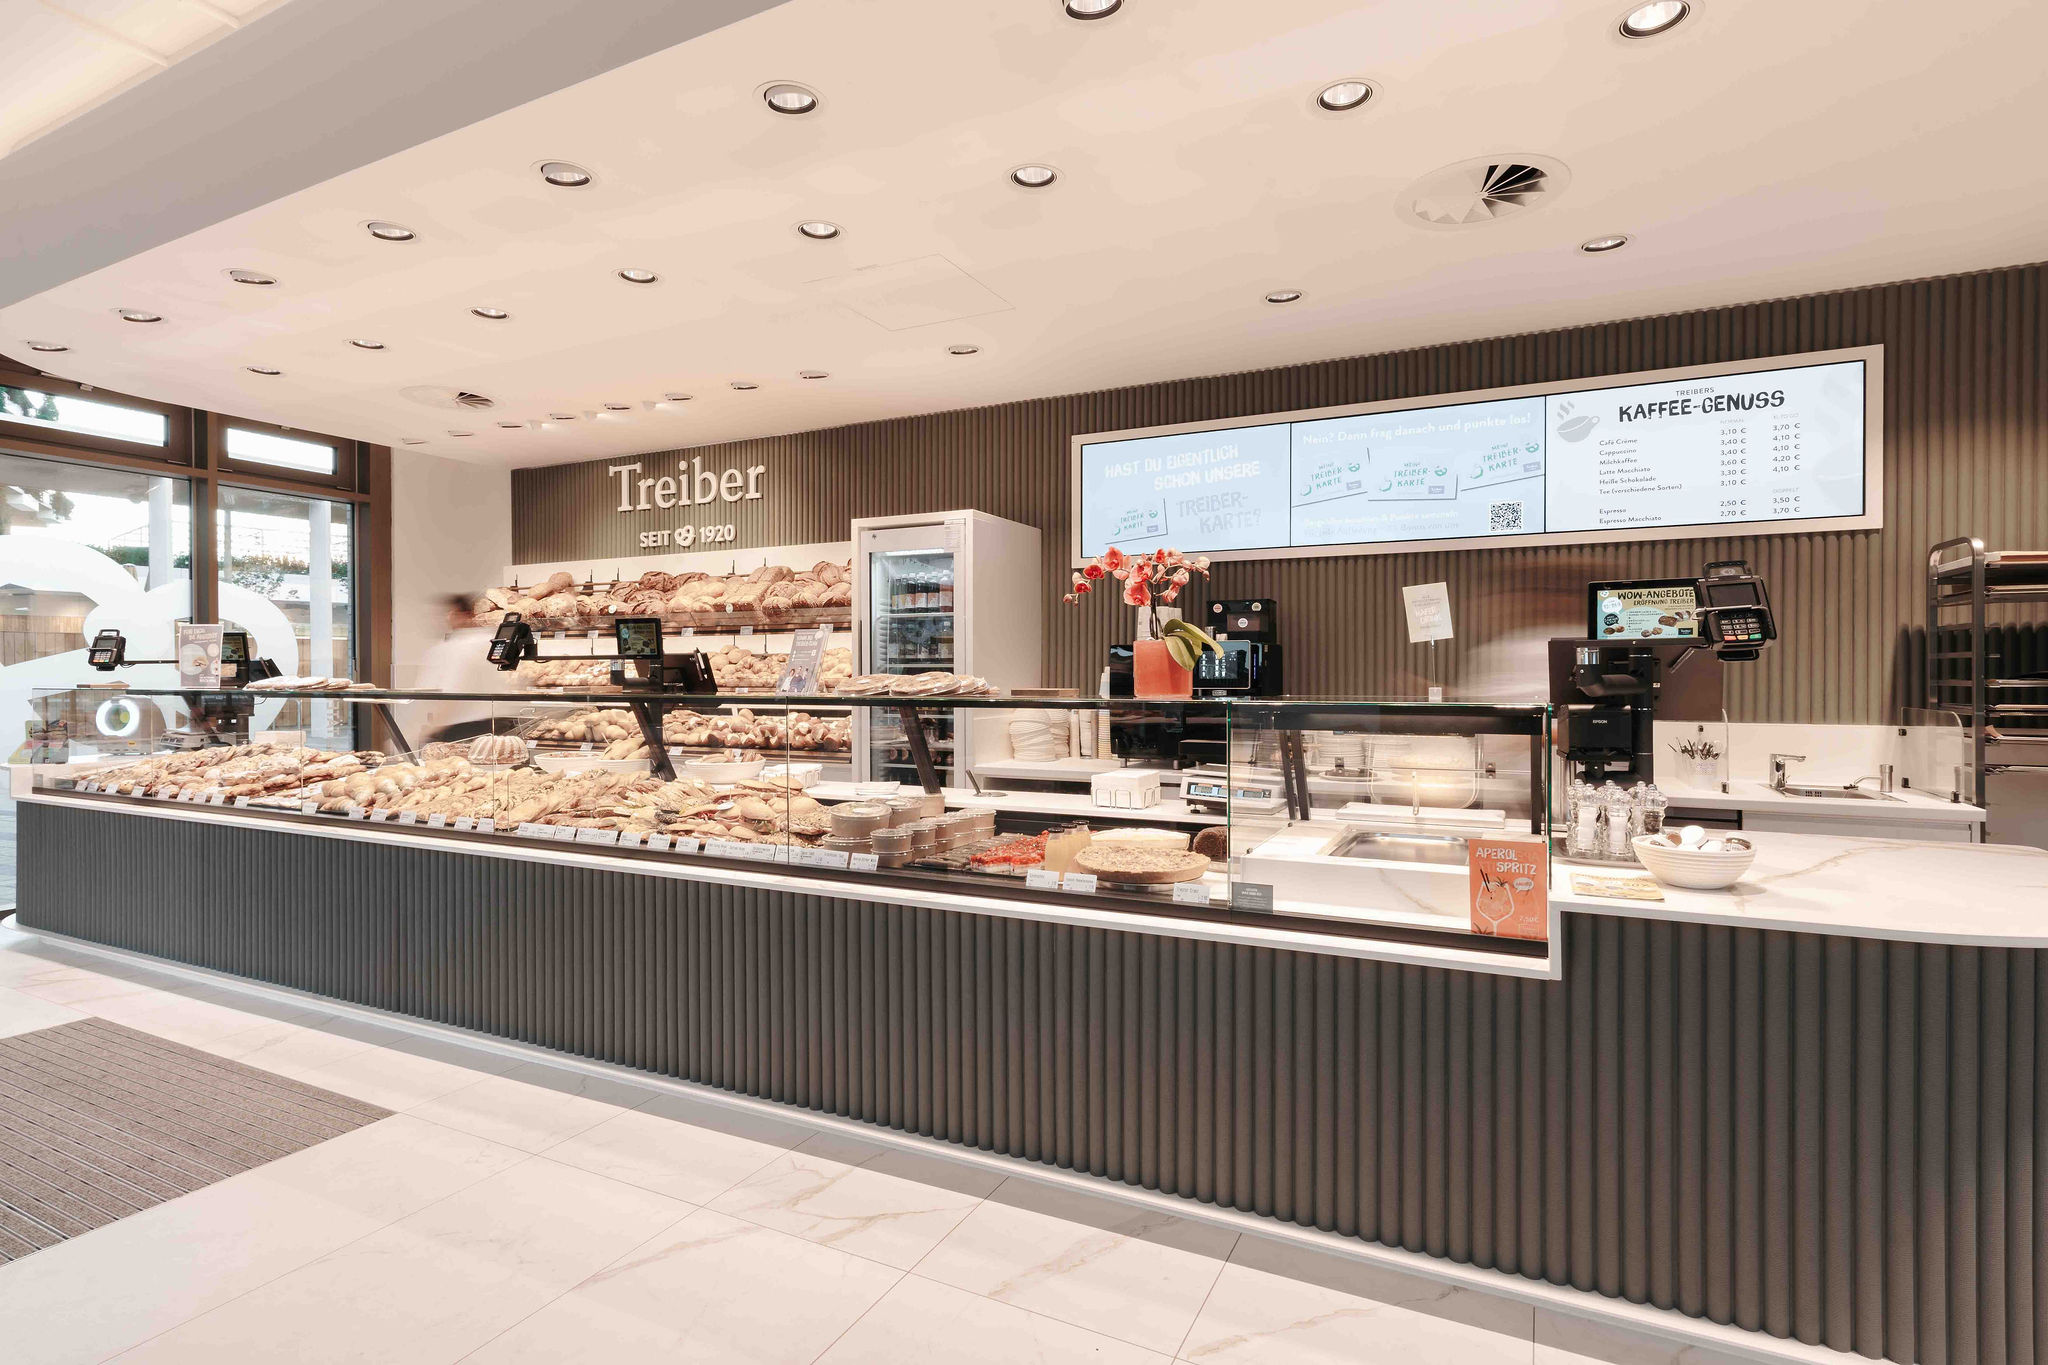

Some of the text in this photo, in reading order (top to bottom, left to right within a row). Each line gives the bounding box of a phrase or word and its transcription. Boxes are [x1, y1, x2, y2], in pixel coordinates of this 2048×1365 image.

[1676, 387, 1714, 396] TREIBERS
[1619, 390, 1785, 422] KAFFEE-GENUSS
[1304, 412, 1531, 444] Nein? Dann frag danach und punkte los!
[1104, 444, 1238, 478] HAST DU EIGENTLICH
[1600, 448, 1636, 456] Cappuccino
[1488, 458, 1517, 472] KARTE
[608, 456, 766, 512] Treiber
[1154, 461, 1260, 491] SCHON UNSERE
[1316, 477, 1342, 489] KARTE
[1398, 478, 1424, 487] KARTE
[1176, 492, 1248, 517] TREIBER-
[1200, 508, 1261, 534] KARTE?
[640, 524, 736, 548] SEIT 1920
[1618, 588, 1694, 600] WOW-ANGEBOTE
[1476, 847, 1518, 860] APEROL
[1496, 862, 1536, 874] SPRITZ
